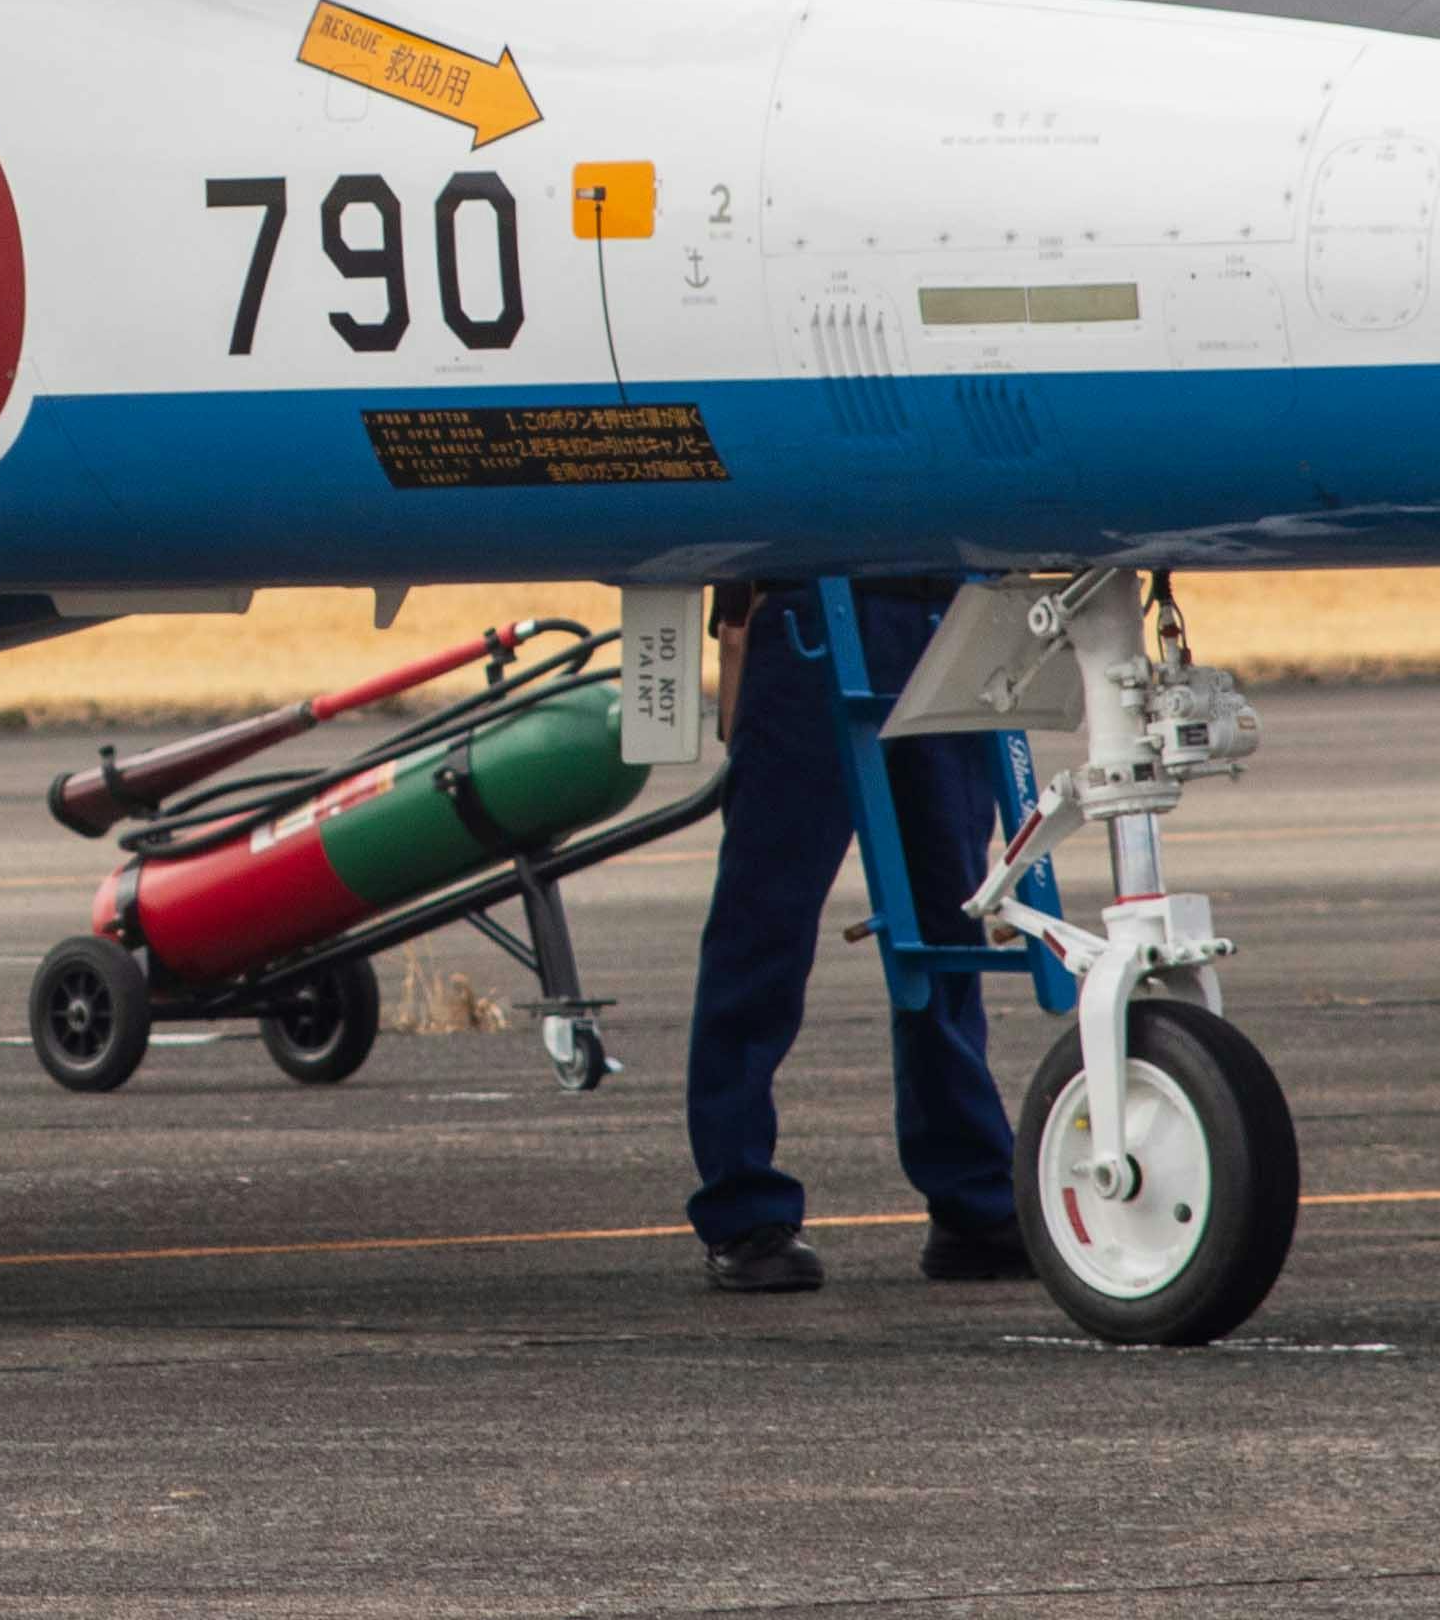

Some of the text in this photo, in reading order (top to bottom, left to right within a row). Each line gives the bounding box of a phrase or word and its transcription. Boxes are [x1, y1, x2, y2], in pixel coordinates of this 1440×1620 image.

[320, 14, 383, 55] RESCUE
[383, 43, 472, 108] 救助用
[708, 182, 733, 224] 2
[205, 171, 525, 356] 790
[638, 636, 654, 718] PAINT
[658, 628, 677, 727] DO NOT
